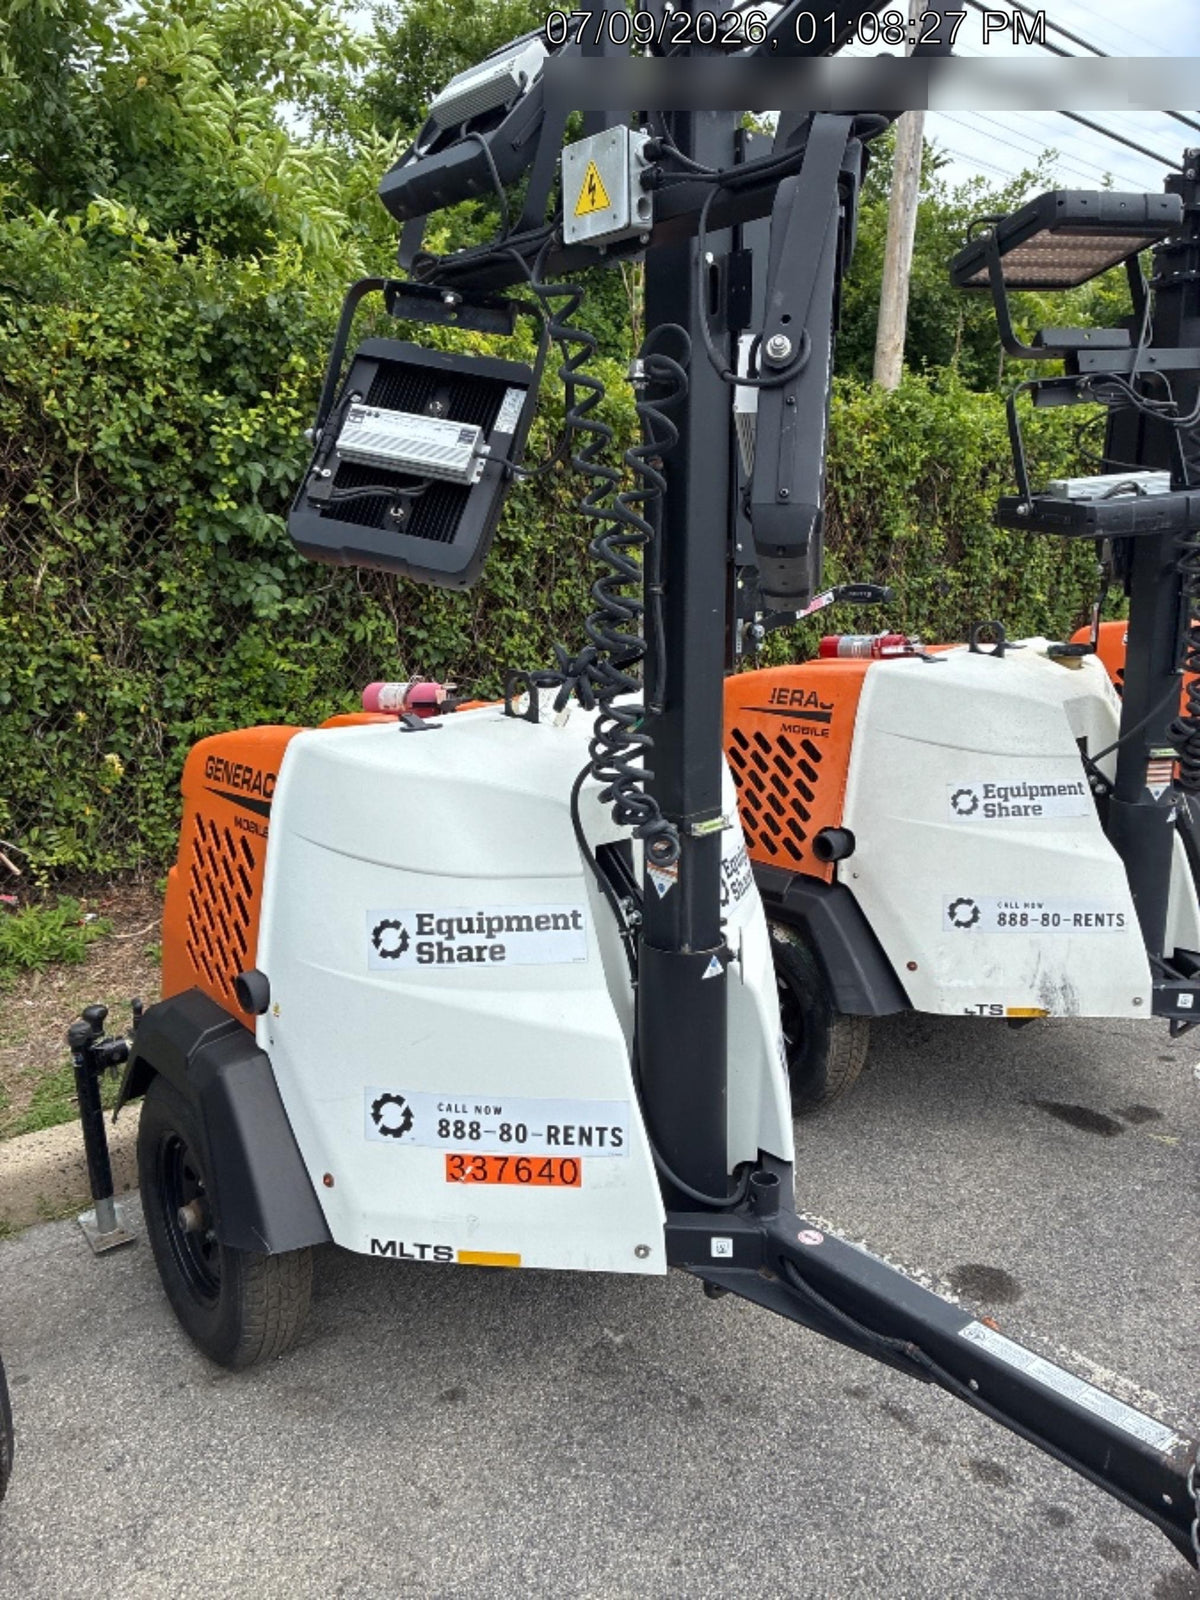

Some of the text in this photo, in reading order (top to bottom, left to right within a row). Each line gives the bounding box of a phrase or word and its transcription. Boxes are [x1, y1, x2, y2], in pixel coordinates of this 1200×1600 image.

[780, 723, 830, 738] MOBILE
[205, 755, 277, 798] GENERAC
[982, 781, 1086, 801] Equipment
[983, 801, 1043, 819] Share
[997, 901, 1020, 910] CALL
[415, 909, 583, 941] Equipment
[996, 912, 1126, 928] 888-80-RENTS
[415, 941, 507, 965] Share
[437, 1102, 503, 1116] CALL NOW
[437, 1118, 624, 1148] 888-80-RENTS
[448, 1154, 579, 1186] 337640
[370, 1238, 455, 1262] MLTS
